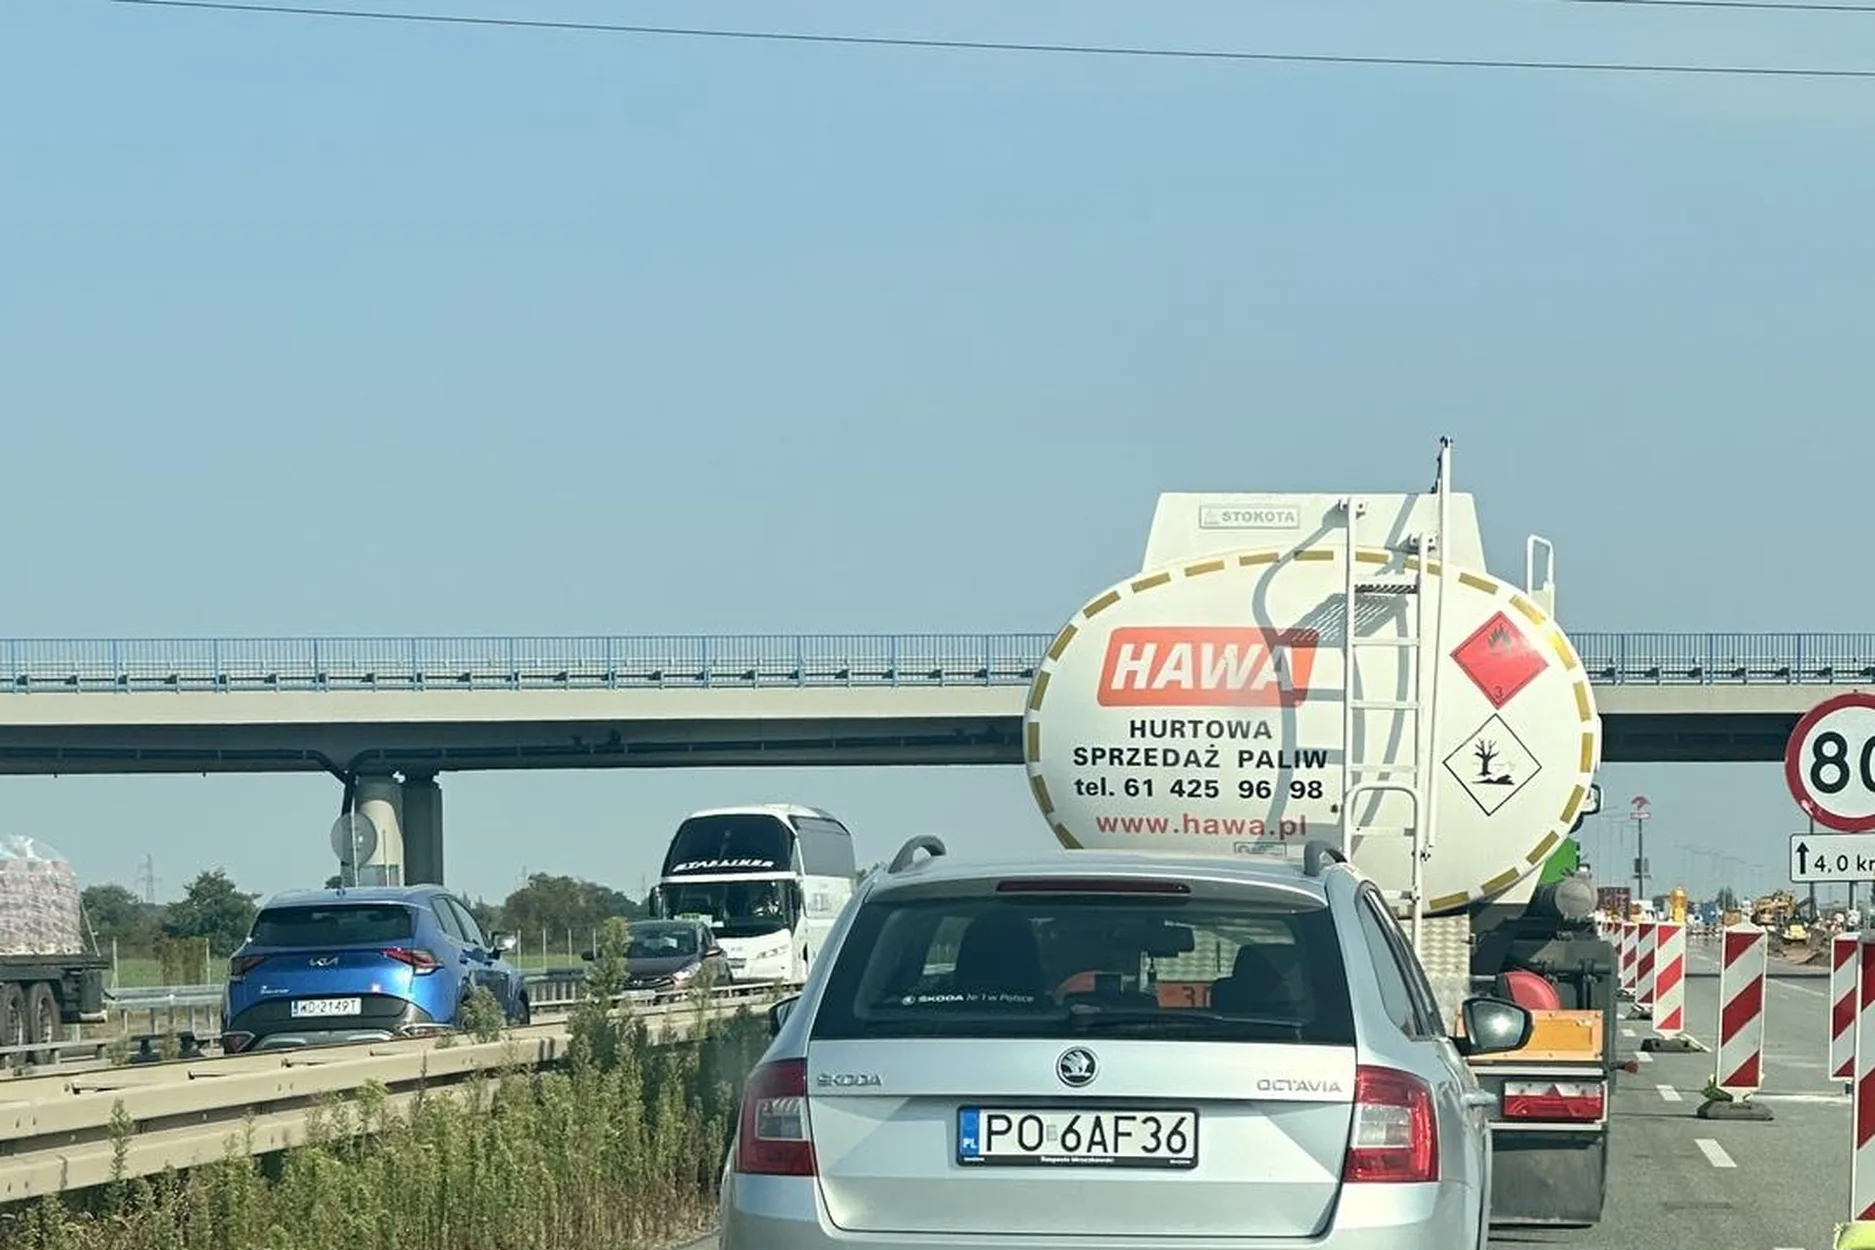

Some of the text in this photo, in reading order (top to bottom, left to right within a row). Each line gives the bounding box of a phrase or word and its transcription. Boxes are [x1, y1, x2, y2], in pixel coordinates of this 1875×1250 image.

[1221, 511, 1296, 523] STOKOTA
[1110, 643, 1293, 691] HAWA
[1494, 685, 1504, 699] 3
[1129, 719, 1273, 740] HURTOWA
[1073, 743, 1328, 770] SPRZEDAŻ PALIW
[1073, 777, 1323, 800] tel. 61 425 96 98
[1096, 813, 1307, 840] www.hawa.pl
[1814, 854, 1849, 873] 4,0
[1256, 1079, 1343, 1093] OCTAVIA
[962, 1137, 978, 1149] PL
[986, 1113, 1187, 1154] PO 6AF36
